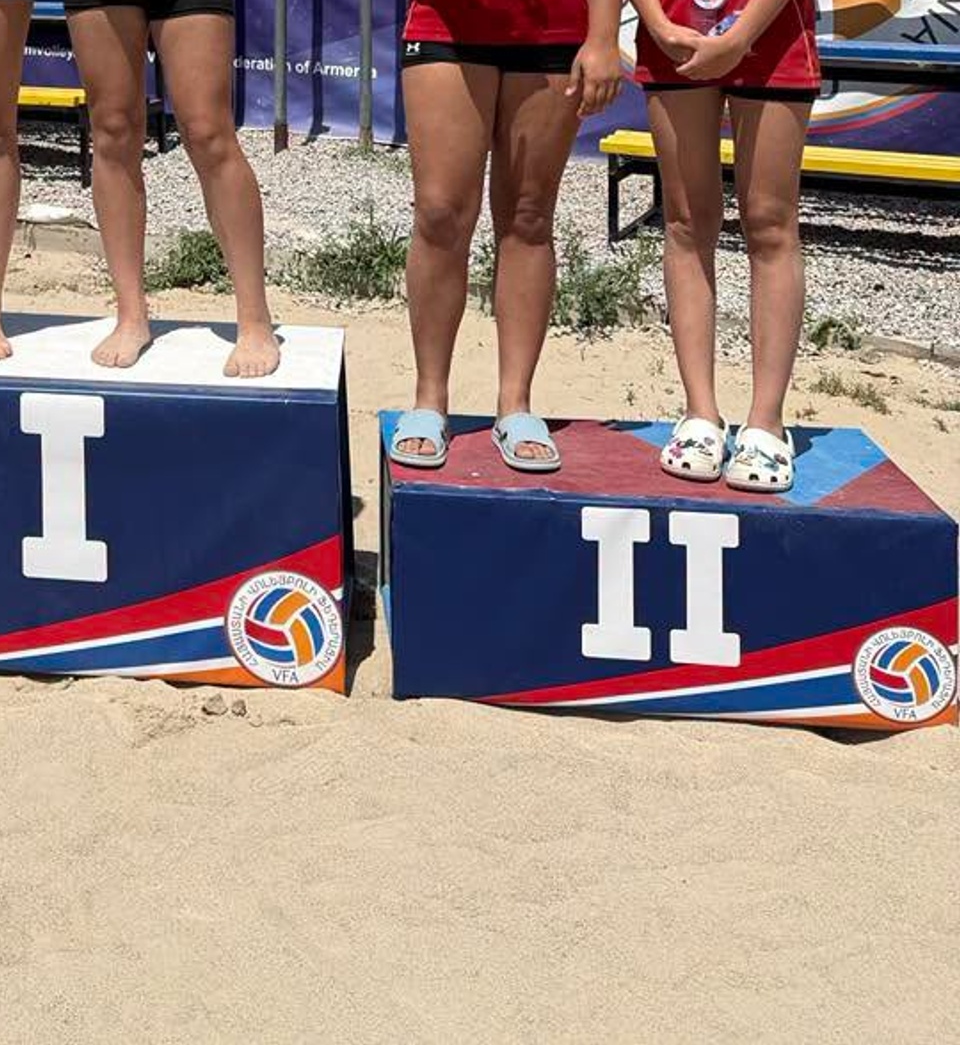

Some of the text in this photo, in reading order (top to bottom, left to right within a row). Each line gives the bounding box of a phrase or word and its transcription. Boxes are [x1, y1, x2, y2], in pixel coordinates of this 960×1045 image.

[295, 60, 310, 74] of
[20, 392, 109, 583] I
[581, 506, 741, 668] II
[271, 668, 300, 683] VFA
[893, 708, 918, 720] VFA
